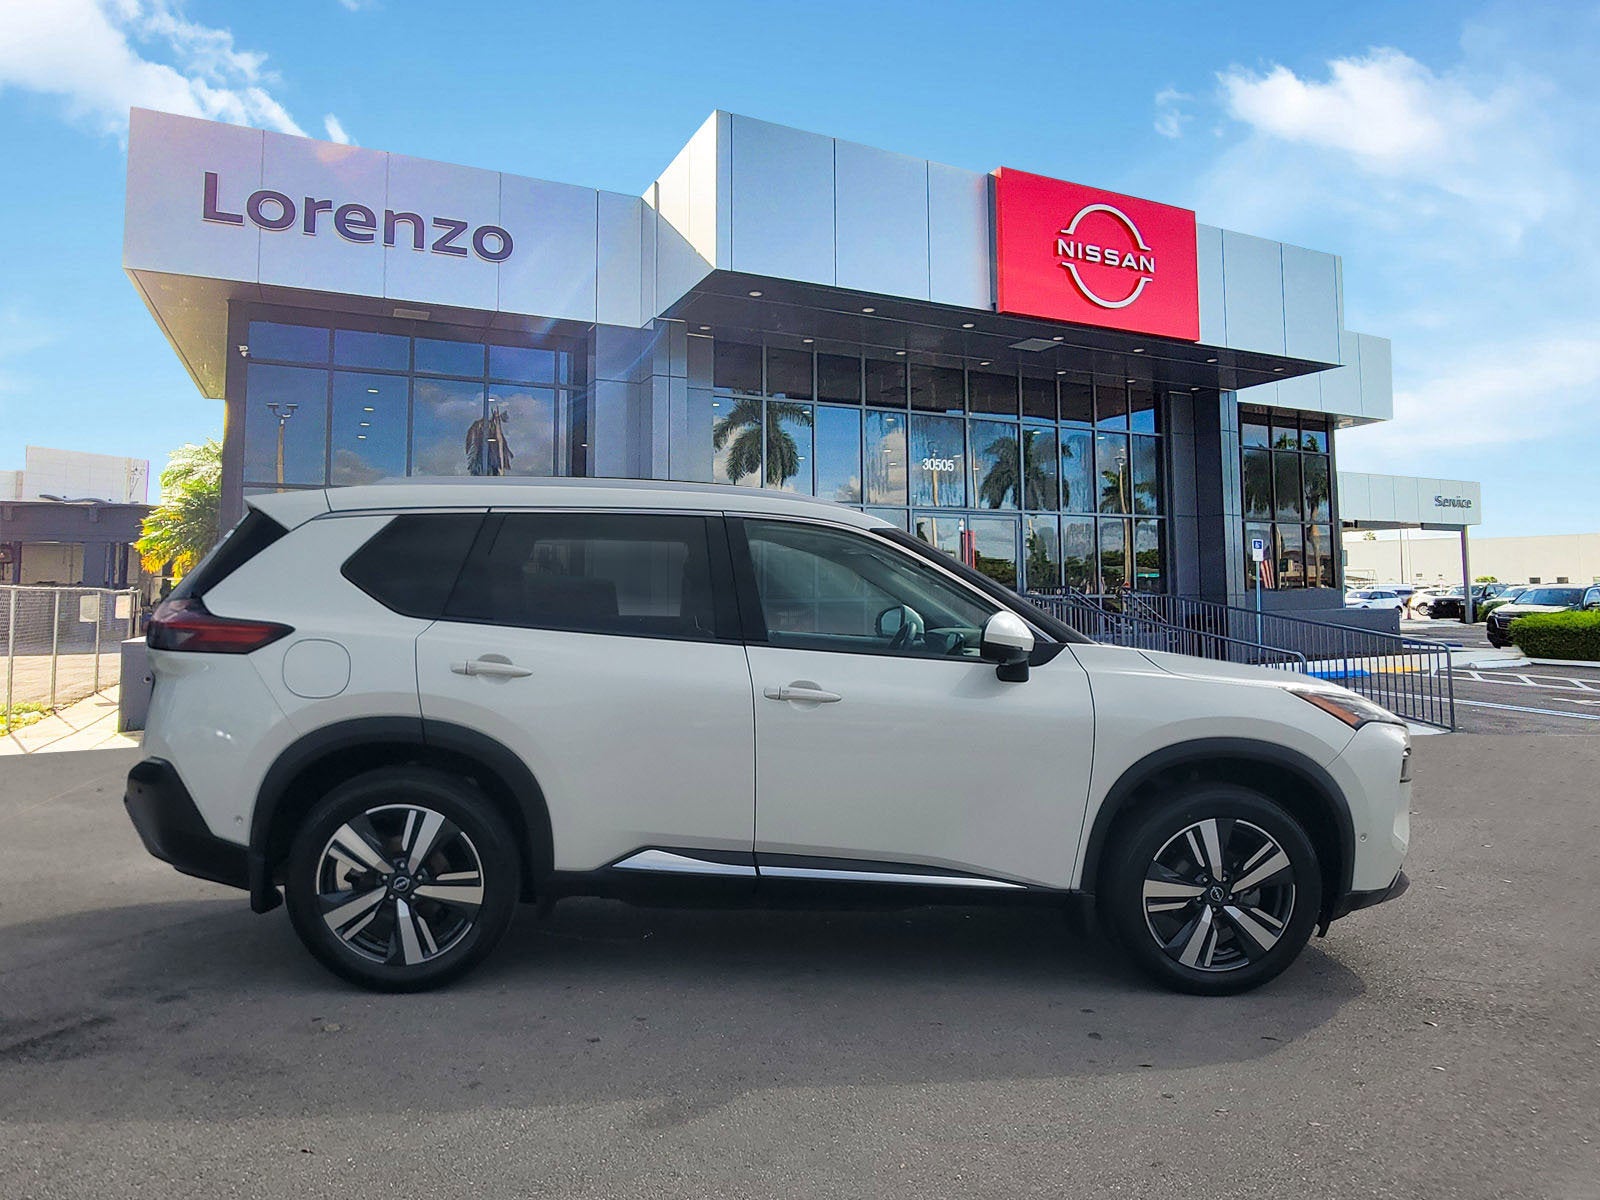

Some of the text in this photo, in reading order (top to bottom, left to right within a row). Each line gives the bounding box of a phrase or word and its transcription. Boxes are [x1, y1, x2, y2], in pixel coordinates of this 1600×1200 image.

[202, 171, 514, 263] Lorenzo
[1057, 238, 1155, 273] NISSAN
[922, 457, 955, 471] 30505
[1434, 495, 1472, 509] Service
